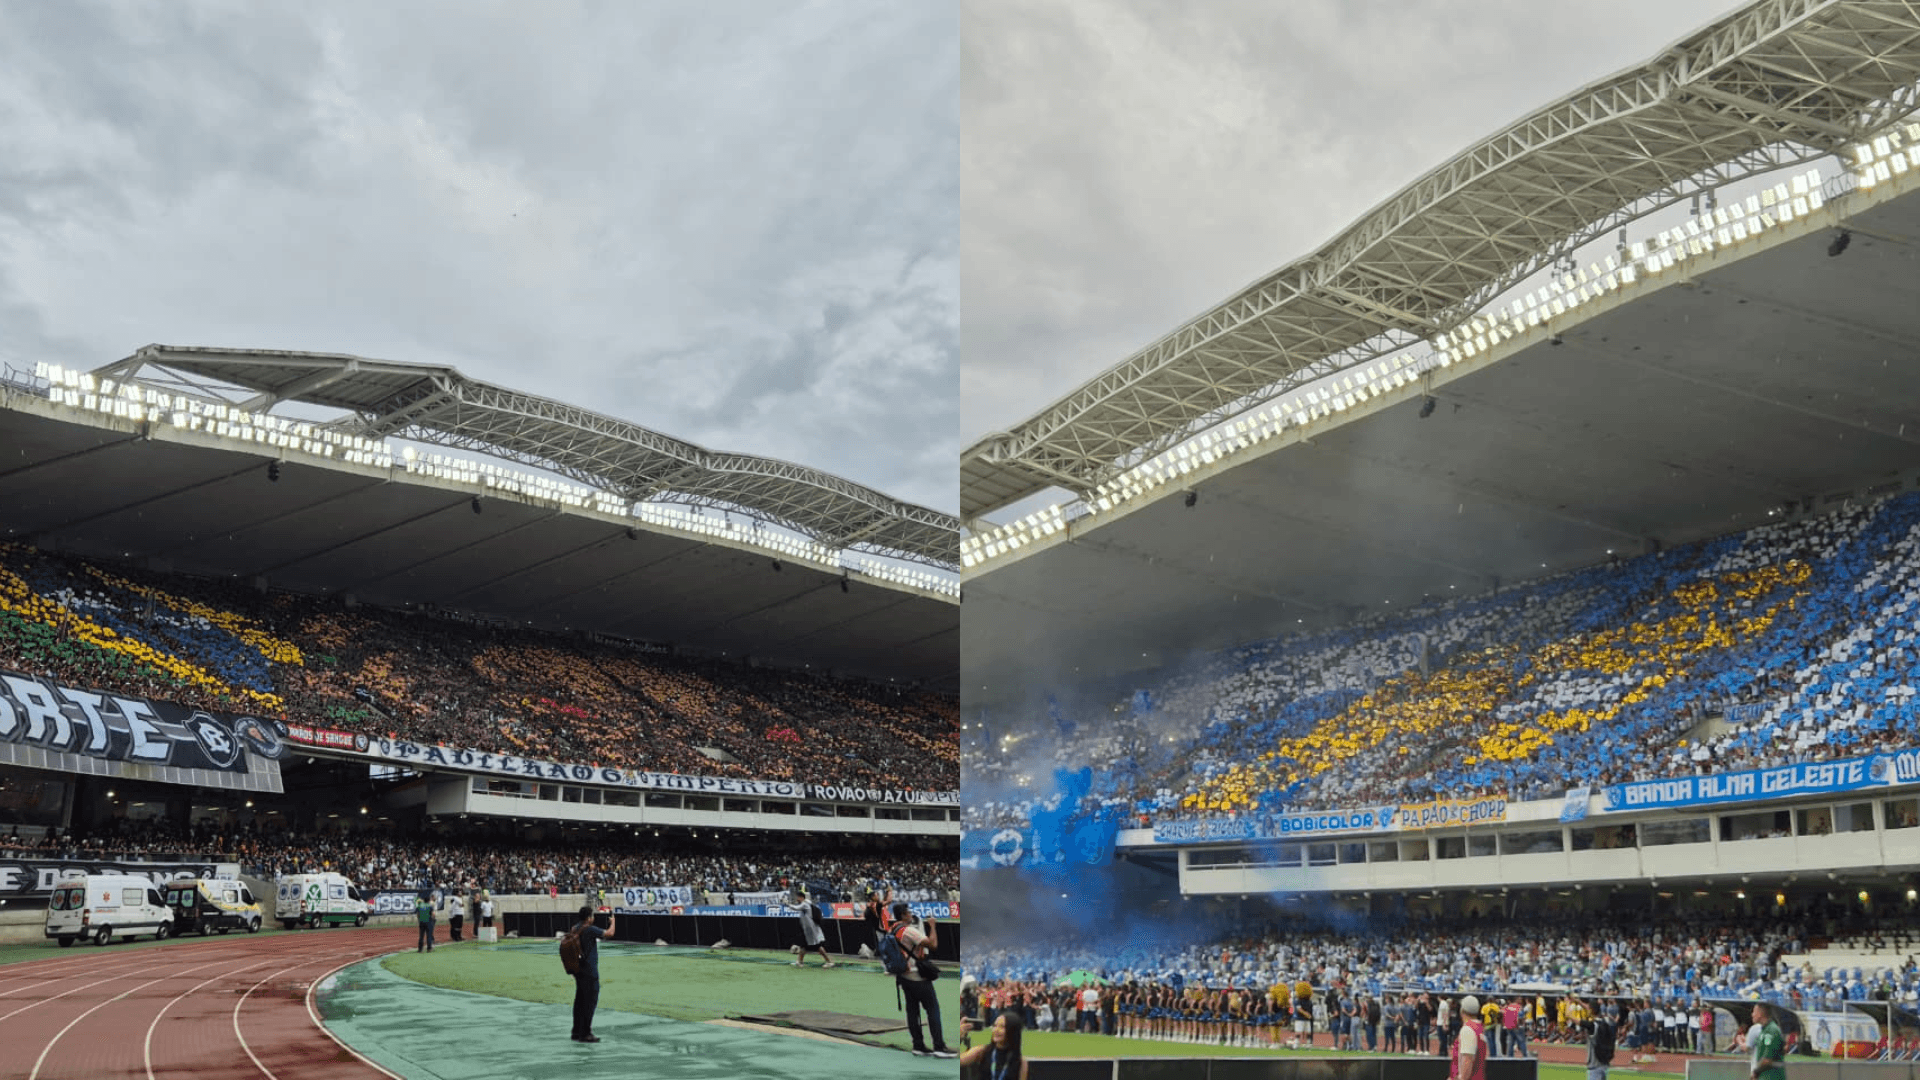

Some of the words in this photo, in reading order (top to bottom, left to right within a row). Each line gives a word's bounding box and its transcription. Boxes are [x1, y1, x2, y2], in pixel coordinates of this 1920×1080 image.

[1625, 780, 1692, 805] BANDA
[1699, 773, 1755, 798] ALMA
[1762, 759, 1864, 791] CELESTE
[1460, 799, 1506, 823] CHOPP
[375, 895, 415, 912] 1905
